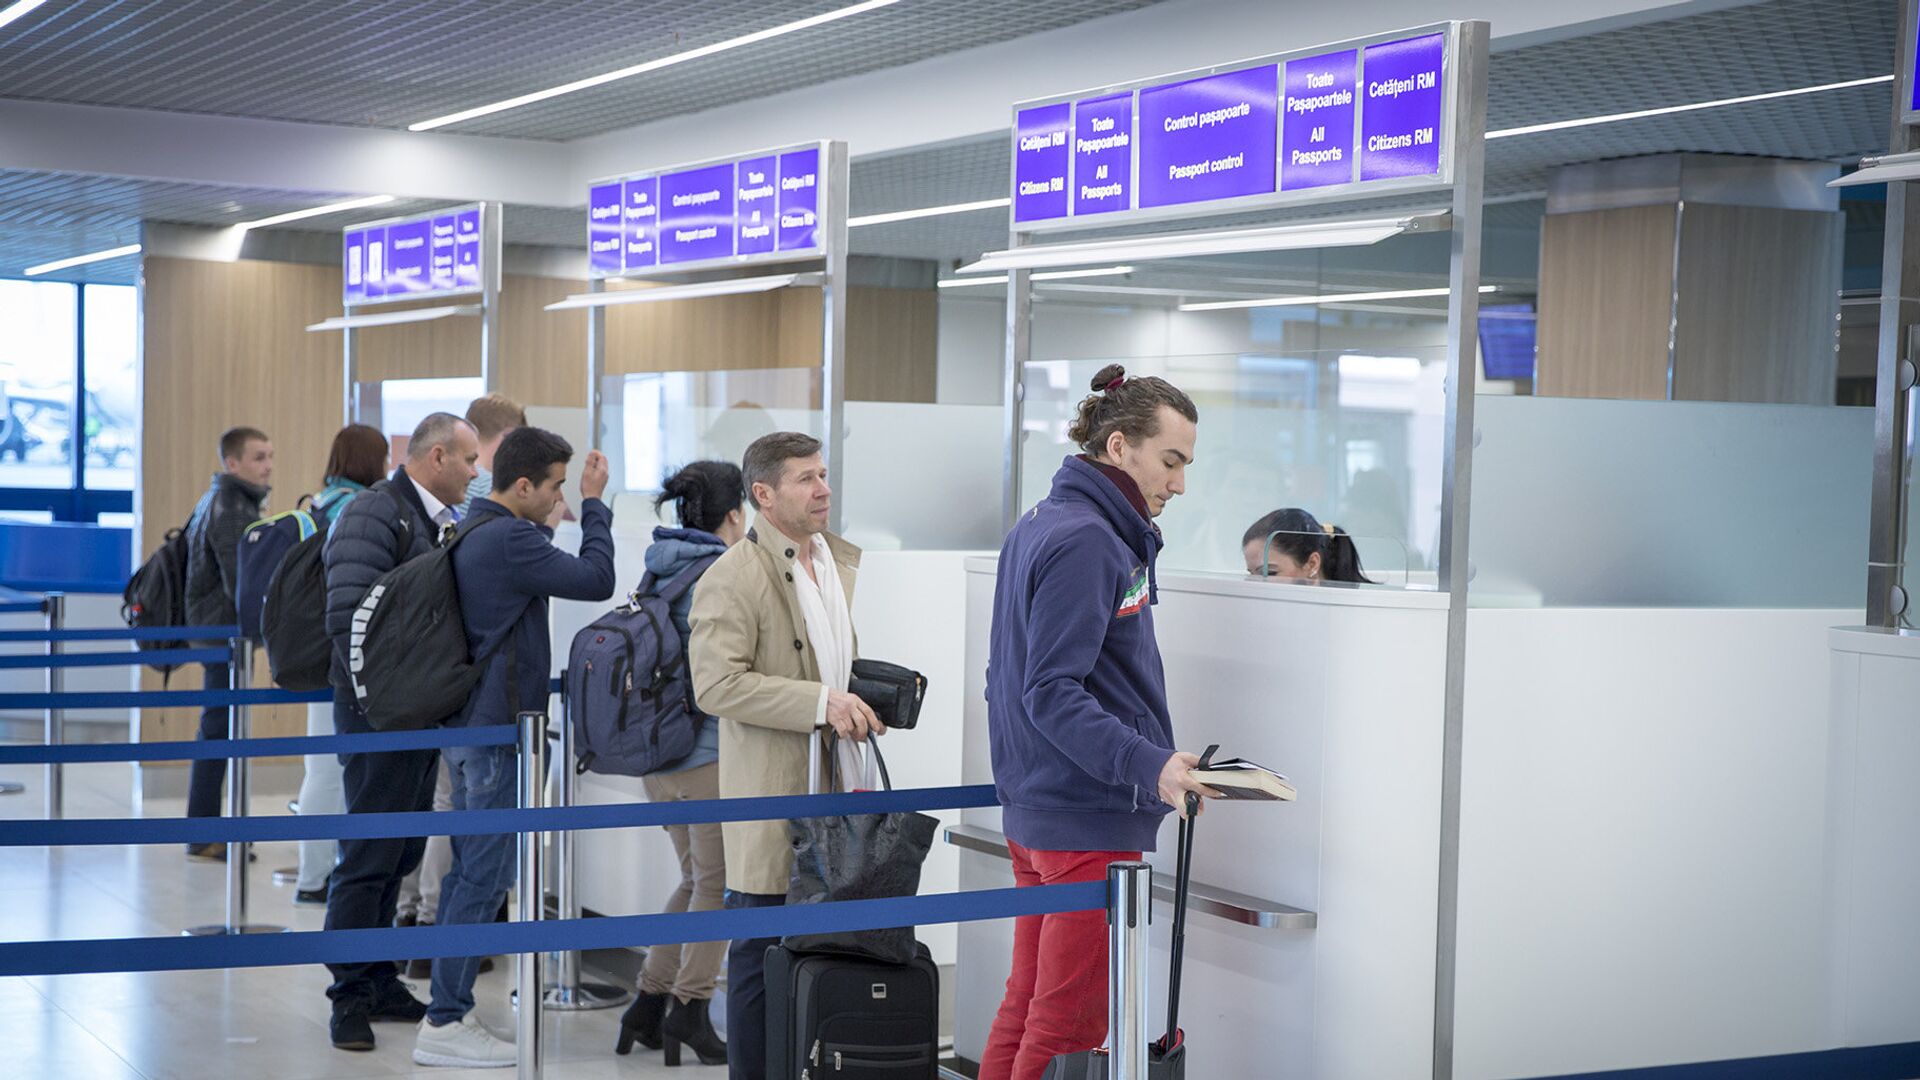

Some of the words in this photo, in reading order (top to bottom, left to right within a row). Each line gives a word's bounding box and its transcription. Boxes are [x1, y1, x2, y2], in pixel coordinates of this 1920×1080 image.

[1306, 72, 1334, 88] Toate
[1417, 72, 1436, 90] RM
[1092, 117, 1114, 132] Toate
[1164, 112, 1198, 132] Control
[1310, 126, 1325, 143] All
[1368, 134, 1412, 152] Citizens
[1414, 127, 1433, 146] RM
[1292, 146, 1342, 166] Passports
[1096, 164, 1108, 180] All
[1169, 160, 1210, 180] Passport
[1210, 152, 1244, 172] control
[1081, 182, 1122, 200] Passports
